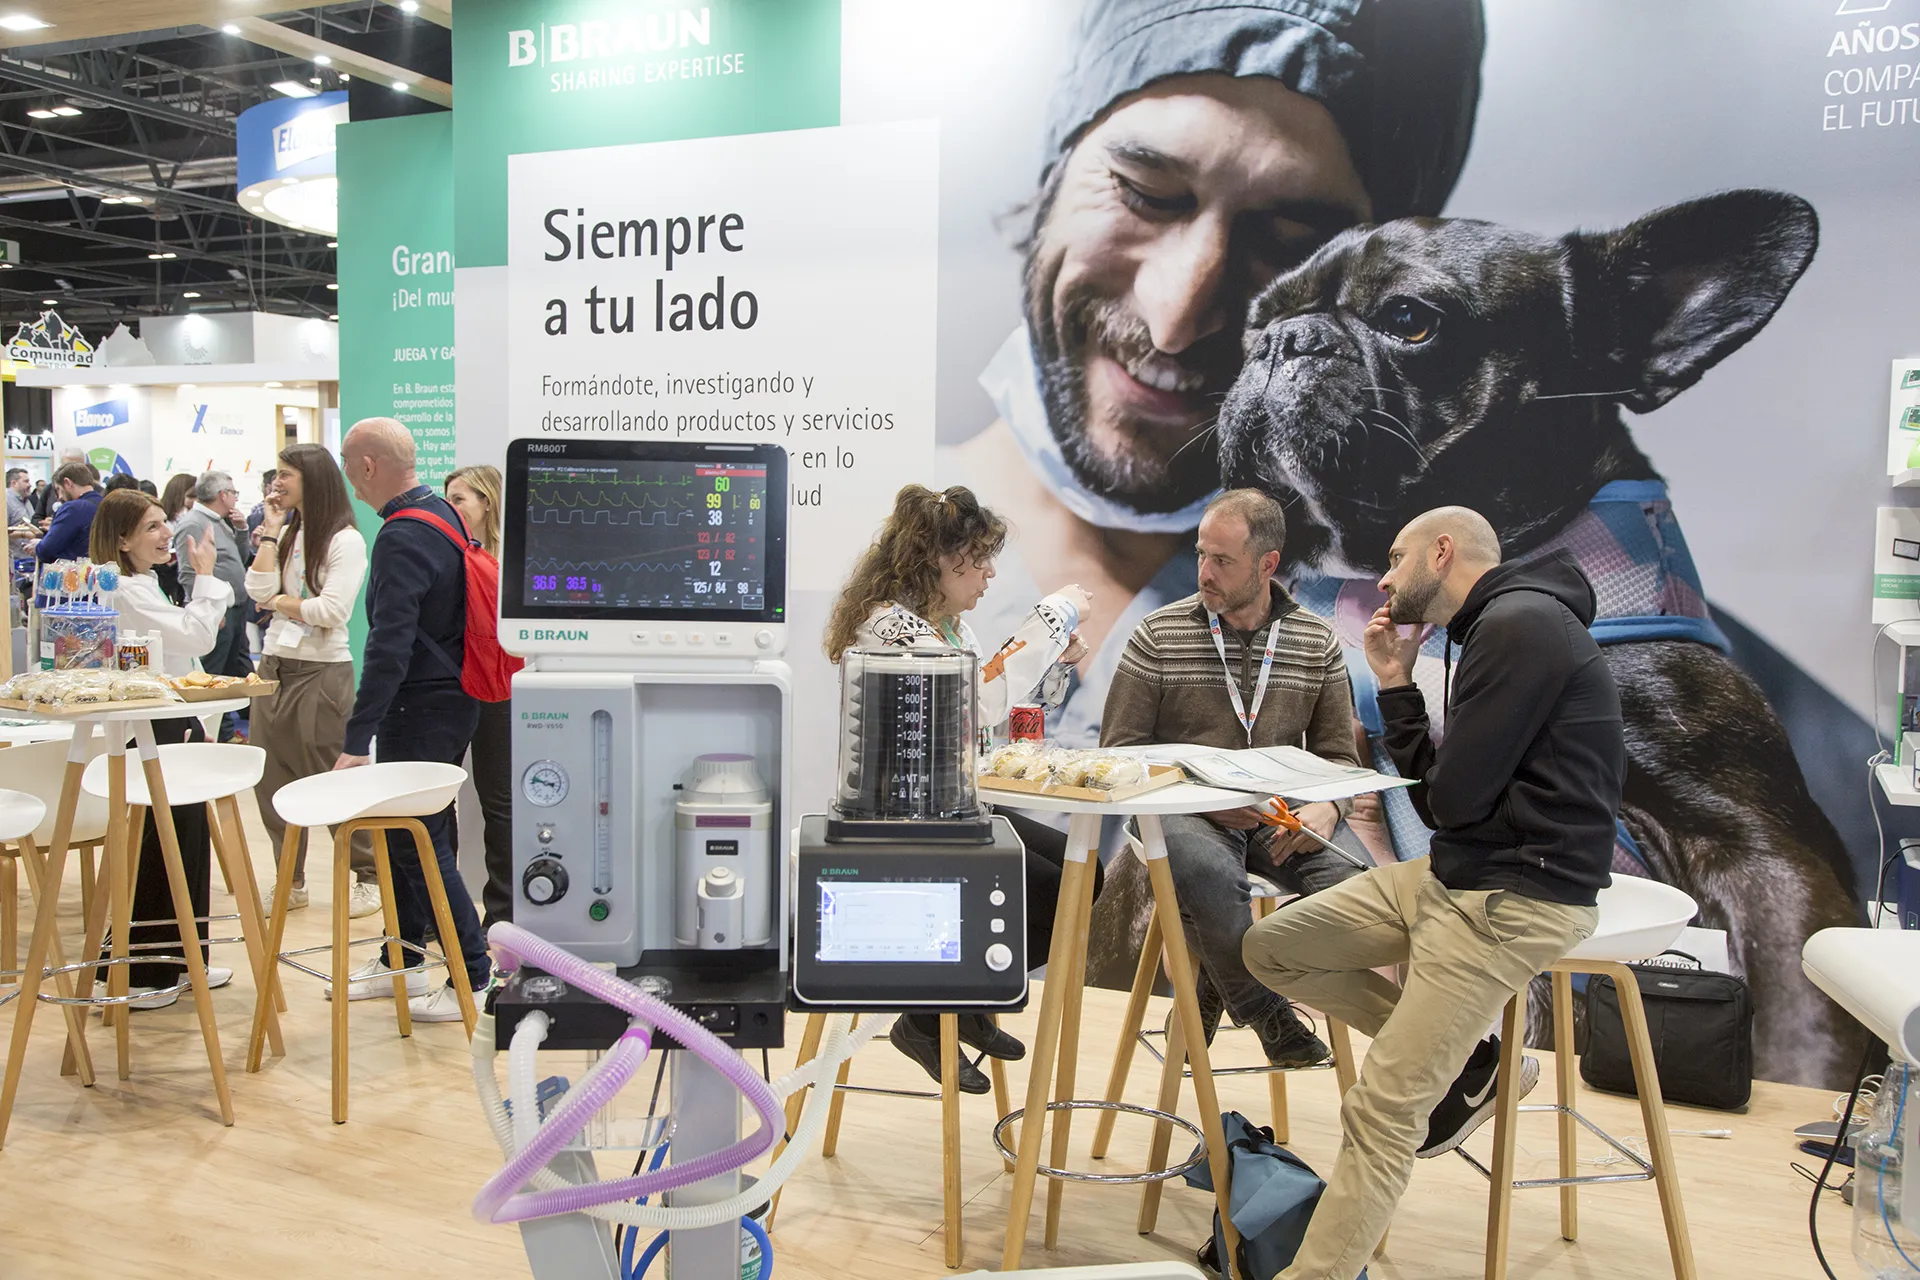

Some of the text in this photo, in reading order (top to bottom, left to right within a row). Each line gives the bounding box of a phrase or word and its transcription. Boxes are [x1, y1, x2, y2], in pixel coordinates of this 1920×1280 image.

[508, 7, 710, 67] B BRAUN
[1826, 20, 1920, 57] AÑOS
[550, 53, 744, 92] SHARING EXPERTISE
[1823, 104, 1852, 131] EL
[544, 207, 744, 272] Siempre
[392, 244, 455, 276] Gran
[393, 287, 421, 312] ¡Del
[544, 275, 759, 336] a tu lado
[10, 346, 93, 363] Comunidad
[393, 347, 428, 362] JUEGA
[430, 347, 438, 360] Y
[393, 383, 403, 394] En
[415, 382, 438, 394] Braun
[542, 371, 814, 400] Formándote, investigando y
[393, 396, 453, 410] comprometidos
[76, 410, 114, 427] Elanco
[393, 411, 453, 422] desarrollo de la
[541, 407, 894, 437] desarrollando productos y servicios
[413, 428, 423, 436] no
[425, 427, 450, 437] somos
[4, 434, 54, 451] RAM
[423, 440, 438, 453] Hay
[527, 443, 567, 453] RM800T
[427, 456, 442, 468] que
[802, 445, 854, 468] en lo
[715, 476, 730, 492] 60
[706, 493, 721, 509] 99
[791, 483, 821, 506] lud
[708, 510, 722, 526] 38
[709, 560, 722, 576] 12
[532, 575, 556, 590] 36.6
[566, 576, 587, 590] 36.5
[715, 582, 726, 594] 84
[737, 582, 748, 594] 98
[519, 629, 588, 641] B BRAUN
[905, 676, 920, 686] 300
[904, 694, 920, 704] 600
[532, 712, 569, 720] BRAUN
[904, 712, 920, 722] 900
[902, 730, 922, 740] 1200
[902, 748, 922, 759] 1500
